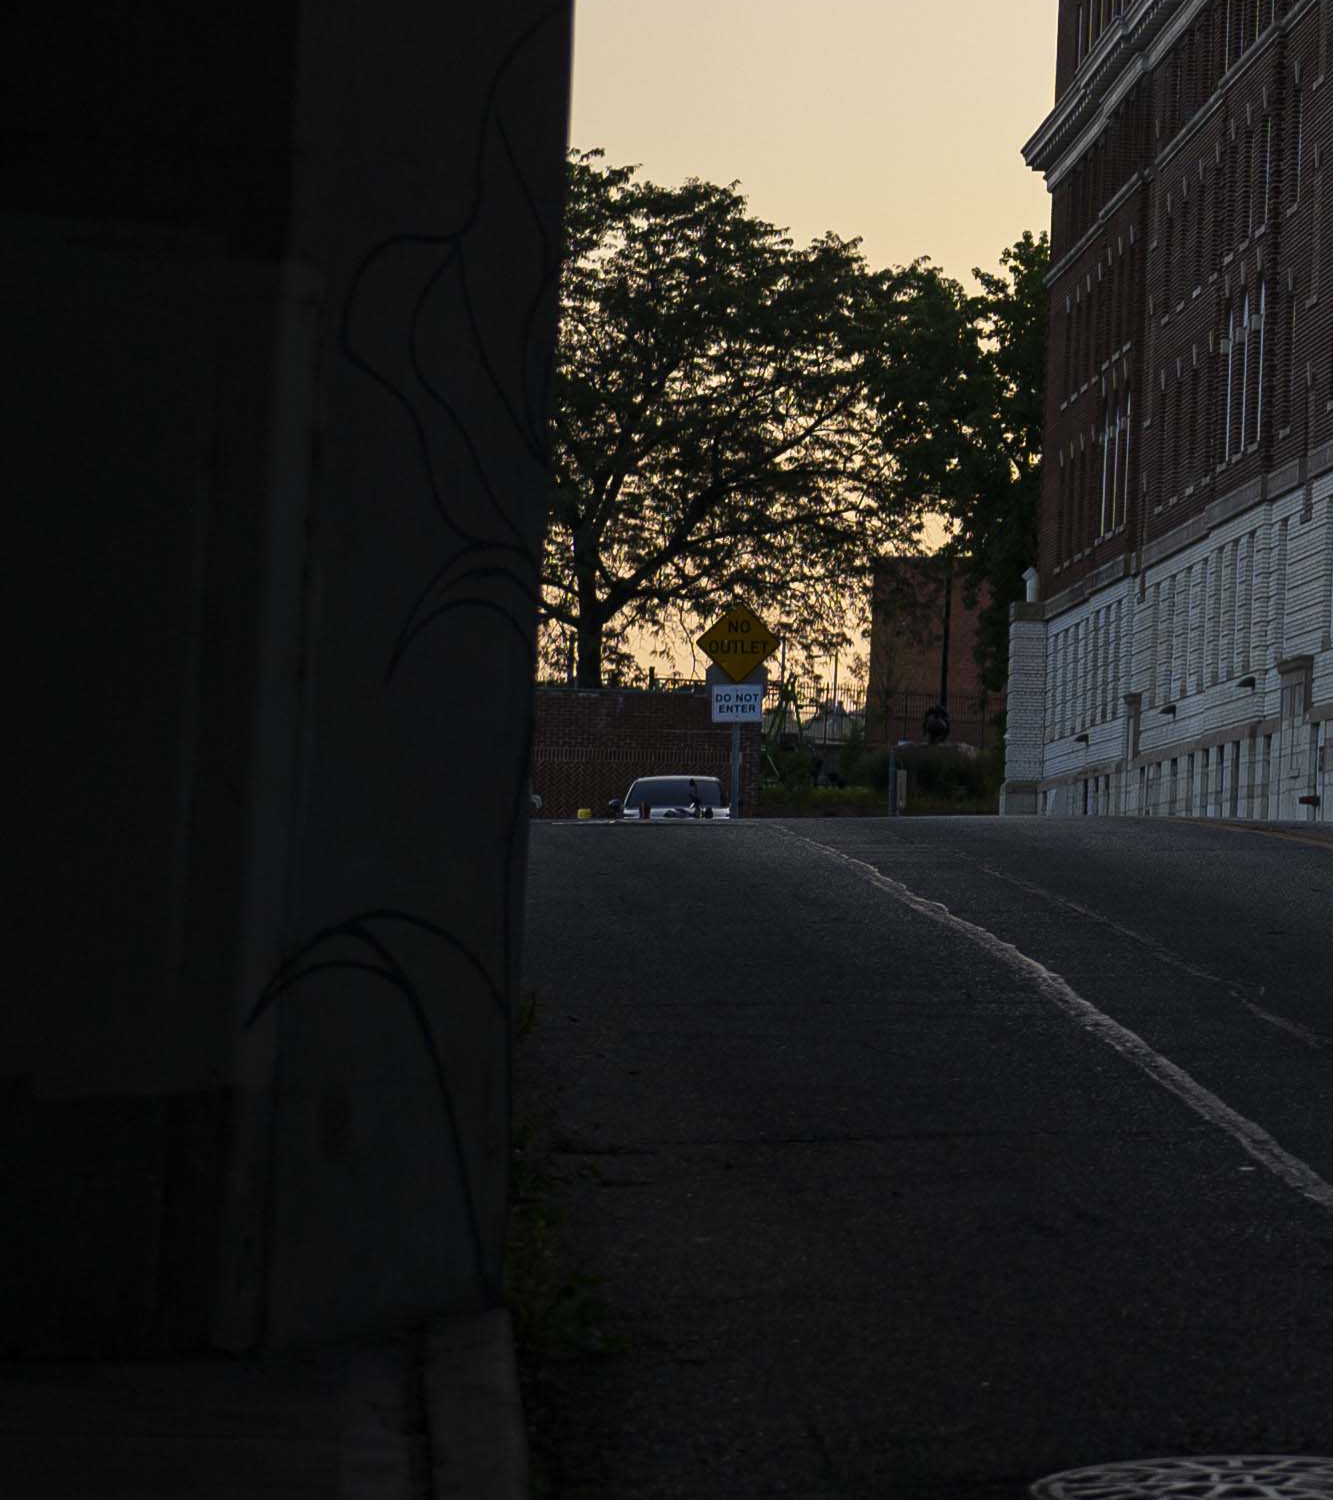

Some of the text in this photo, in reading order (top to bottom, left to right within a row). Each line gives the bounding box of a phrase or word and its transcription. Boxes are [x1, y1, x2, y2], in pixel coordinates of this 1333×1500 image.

[729, 620, 751, 633] NO
[709, 640, 769, 654] OUTLET
[716, 694, 760, 703] DO NOT
[719, 704, 756, 713] ENTER
